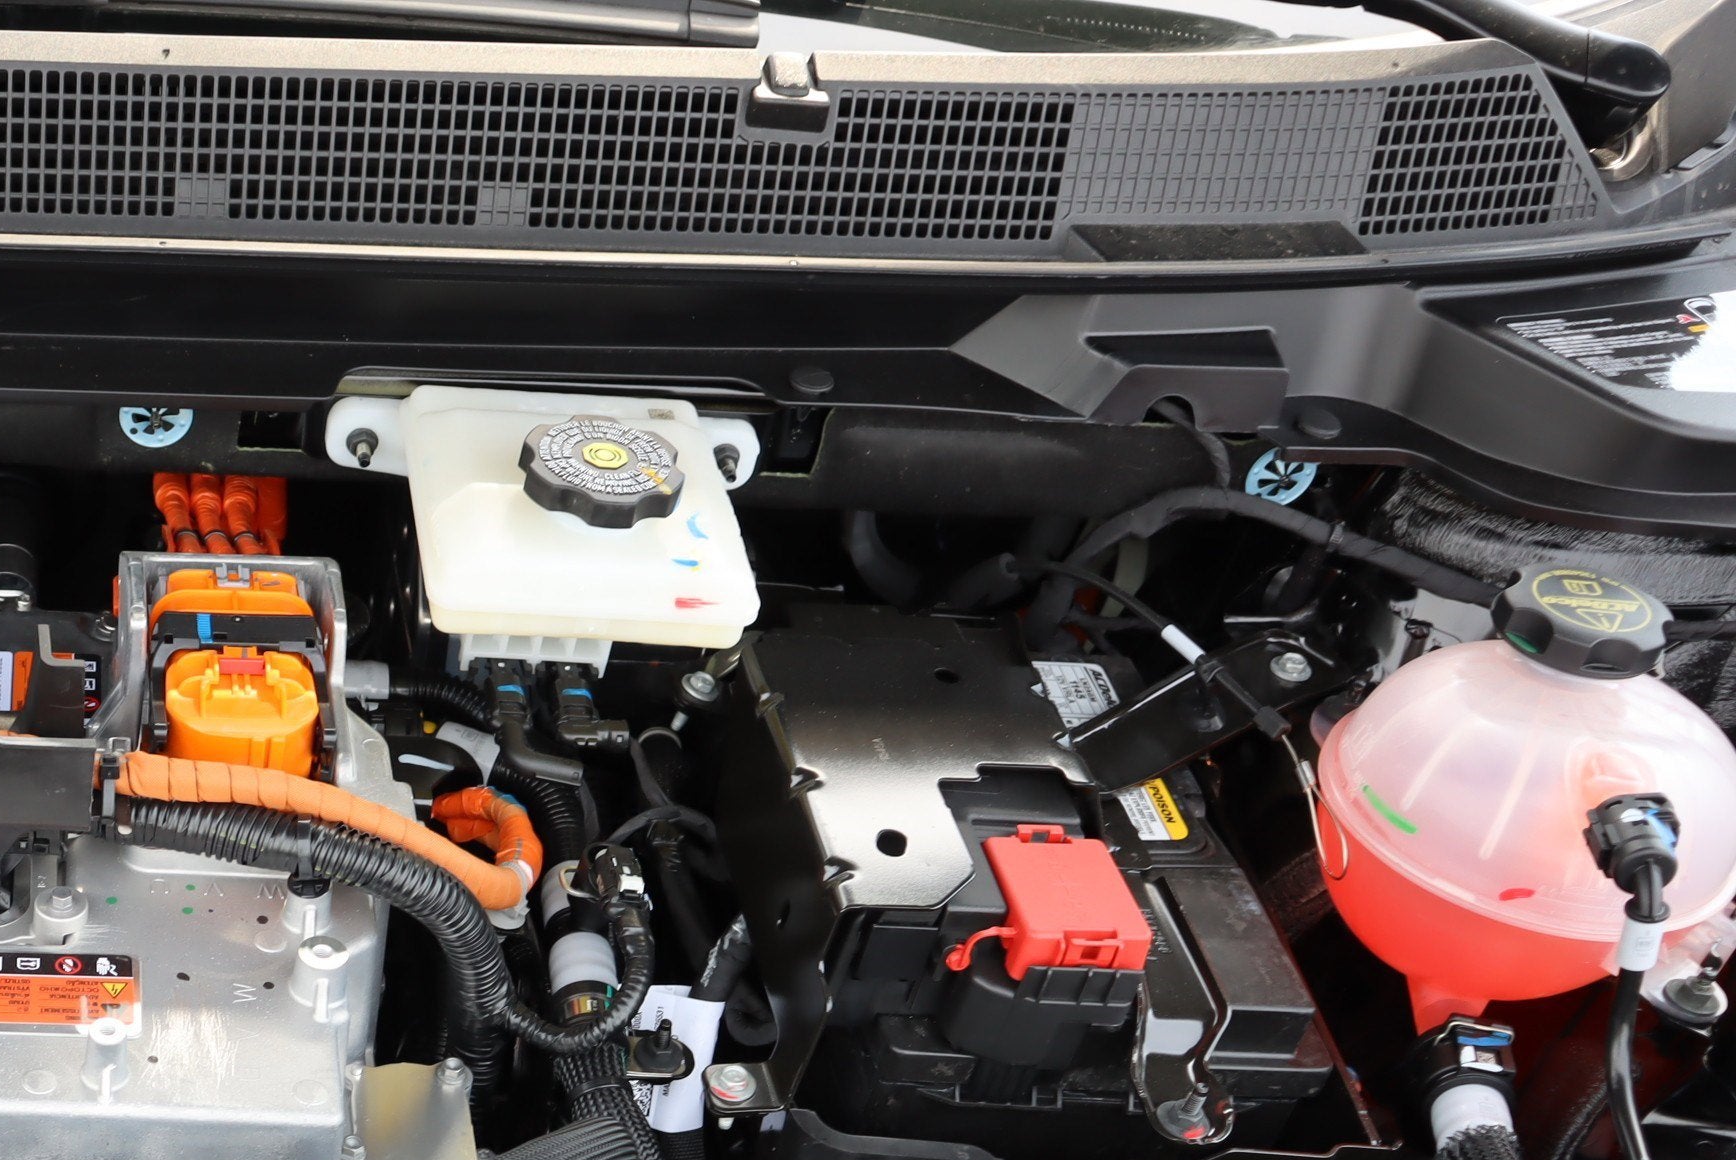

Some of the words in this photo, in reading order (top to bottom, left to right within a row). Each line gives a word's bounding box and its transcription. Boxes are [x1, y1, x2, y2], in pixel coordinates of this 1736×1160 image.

[592, 420, 630, 432] BOUCHON
[581, 482, 605, 493] FROM
[1149, 786, 1176, 823] POISON
